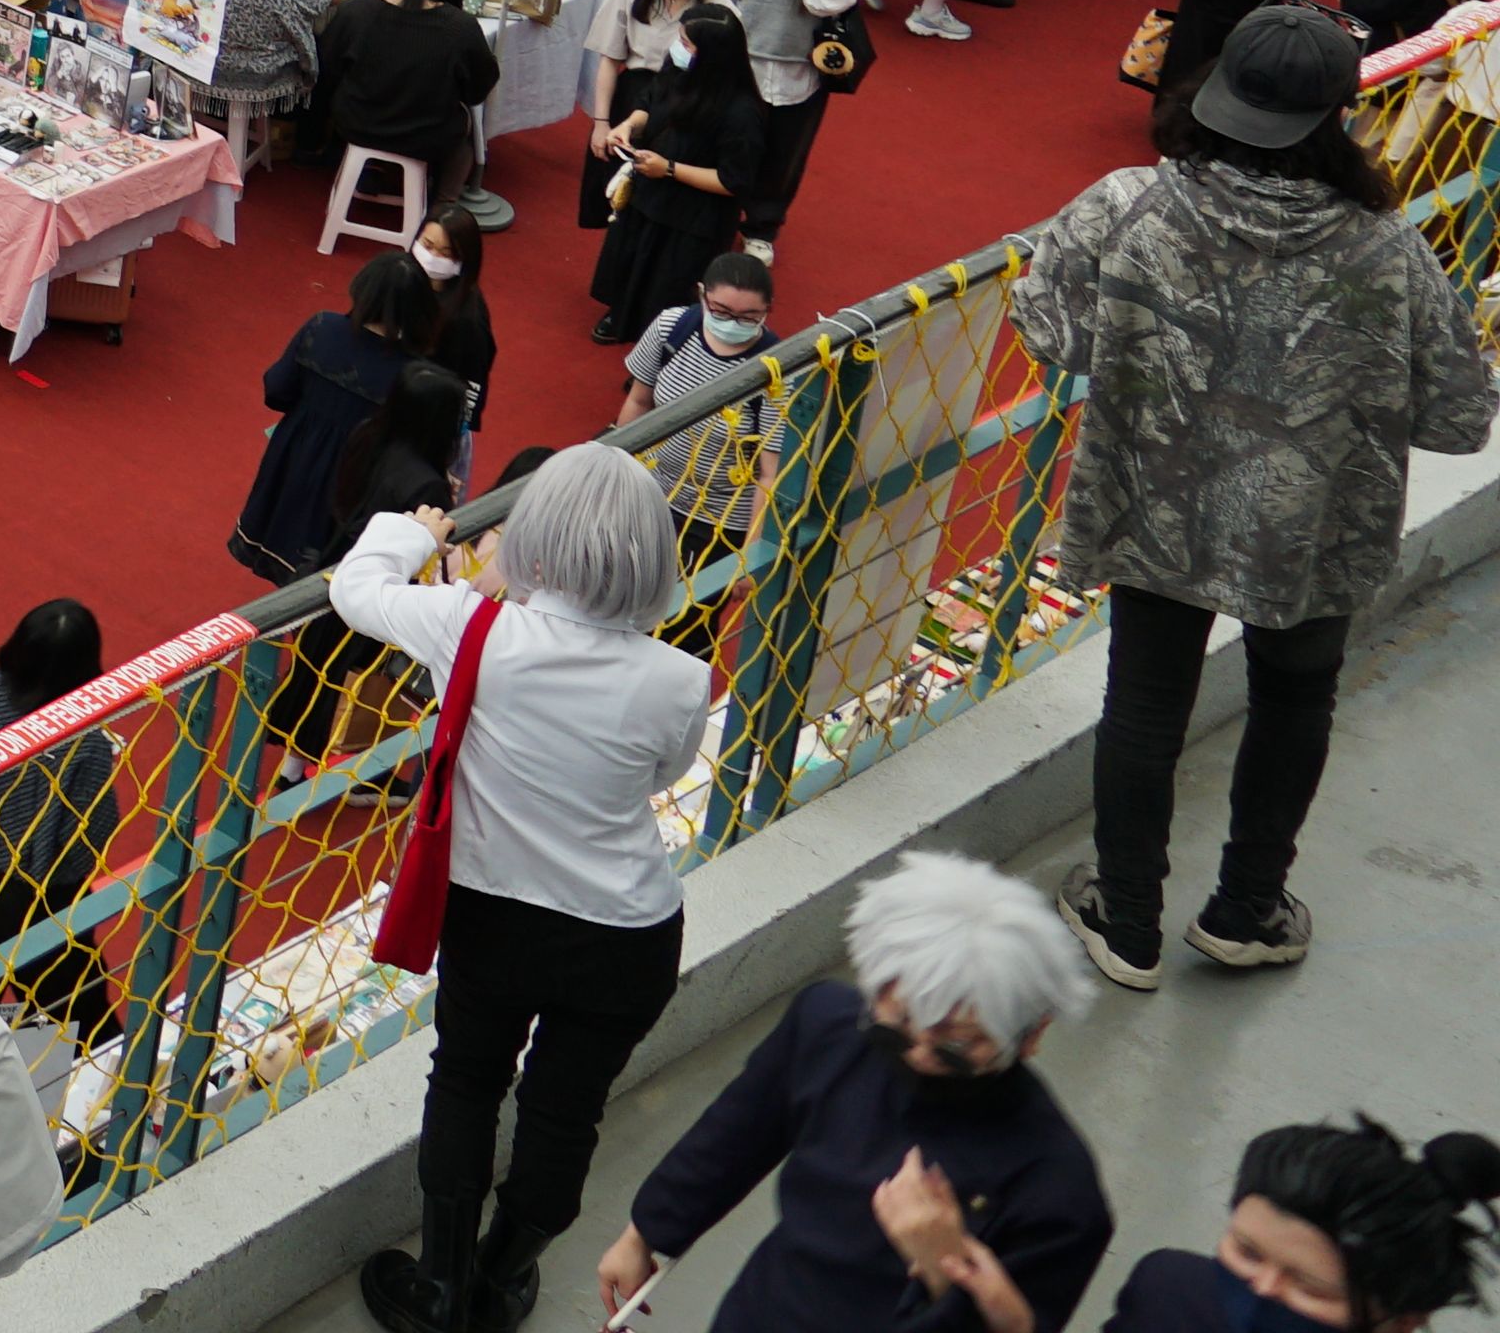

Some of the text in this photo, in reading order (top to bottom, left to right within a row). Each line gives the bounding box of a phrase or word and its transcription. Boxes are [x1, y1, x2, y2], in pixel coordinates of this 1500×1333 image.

[0, 726, 30, 755] ON
[16, 710, 56, 746] THE
[46, 687, 103, 735] FENCE
[92, 673, 130, 711] FOR
[114, 652, 162, 695] YOUR
[151, 635, 193, 669] OWN
